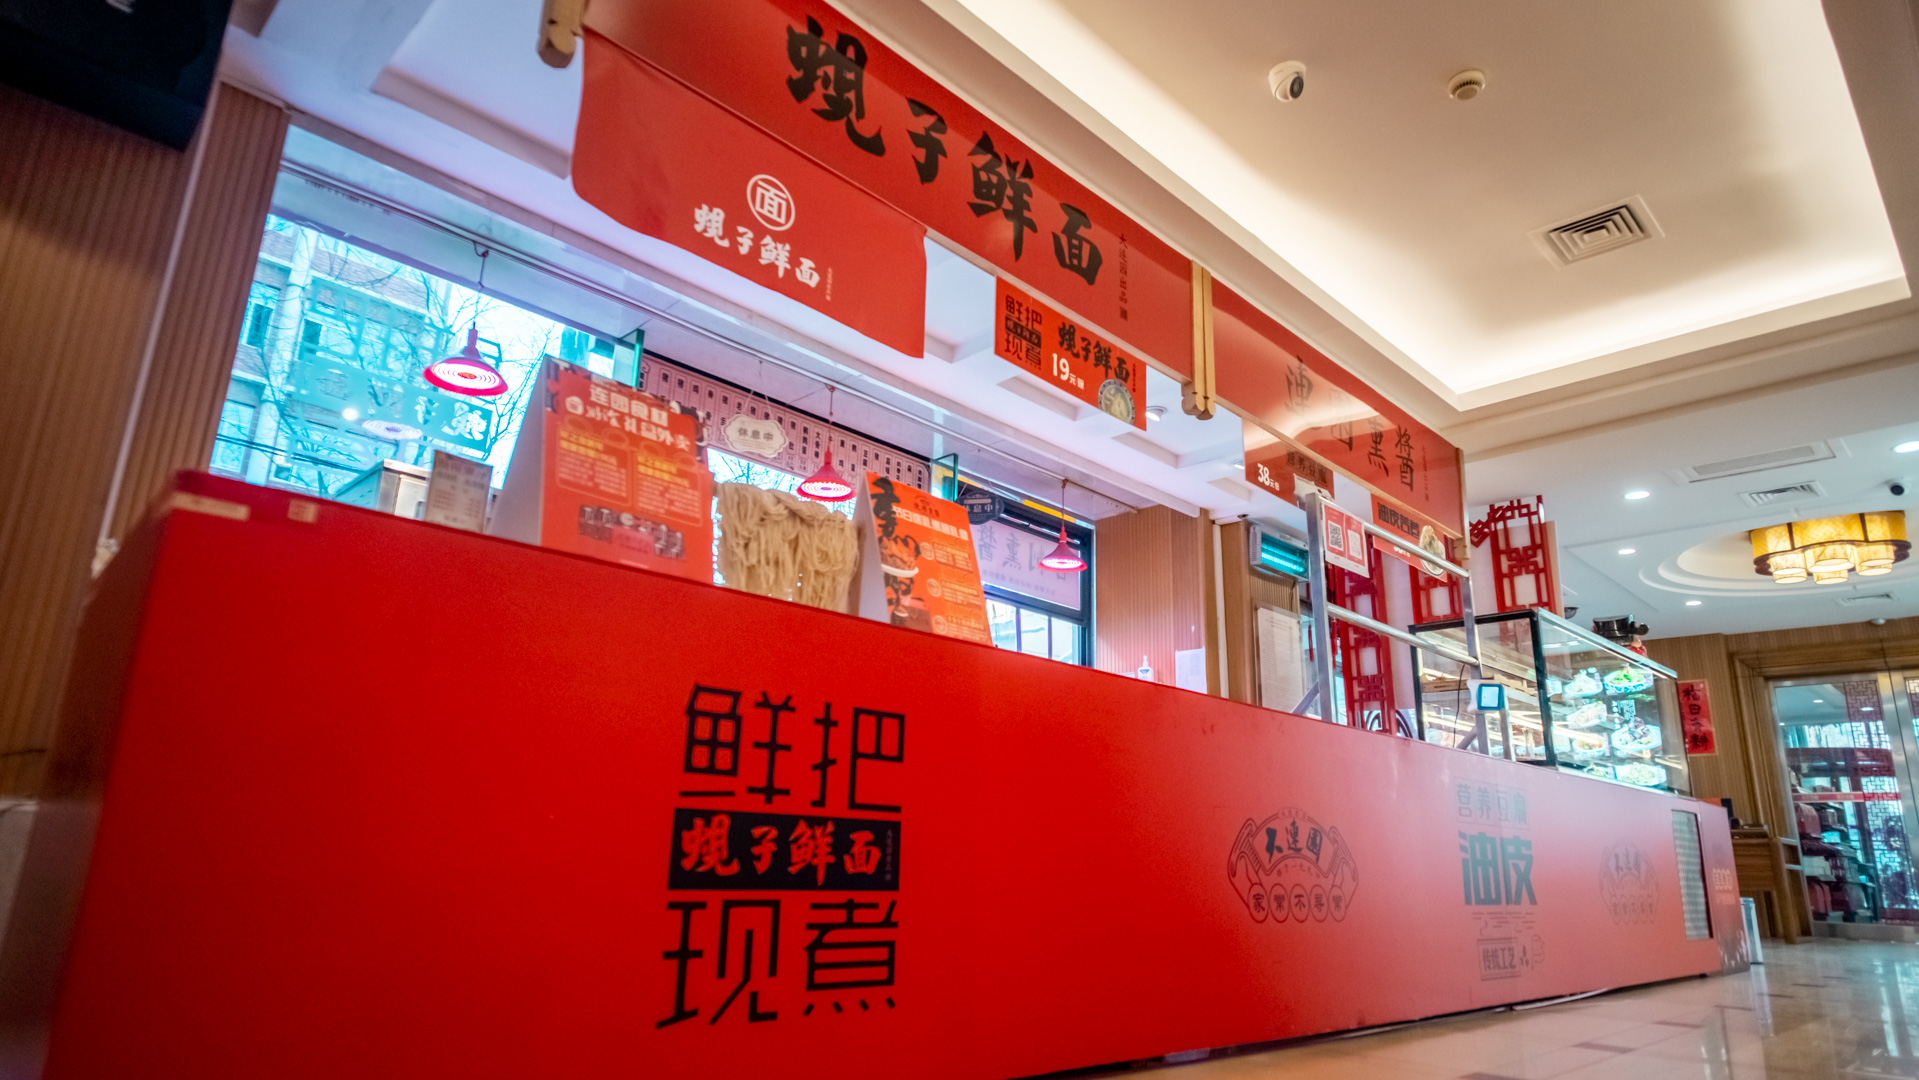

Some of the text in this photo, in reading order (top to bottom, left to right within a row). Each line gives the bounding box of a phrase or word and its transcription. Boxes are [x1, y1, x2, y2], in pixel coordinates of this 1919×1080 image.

[755, 180, 788, 225] 面
[679, 684, 906, 813] 鲜把
[1458, 831, 1538, 906] 油皮
[656, 899, 899, 1030] 现煮
